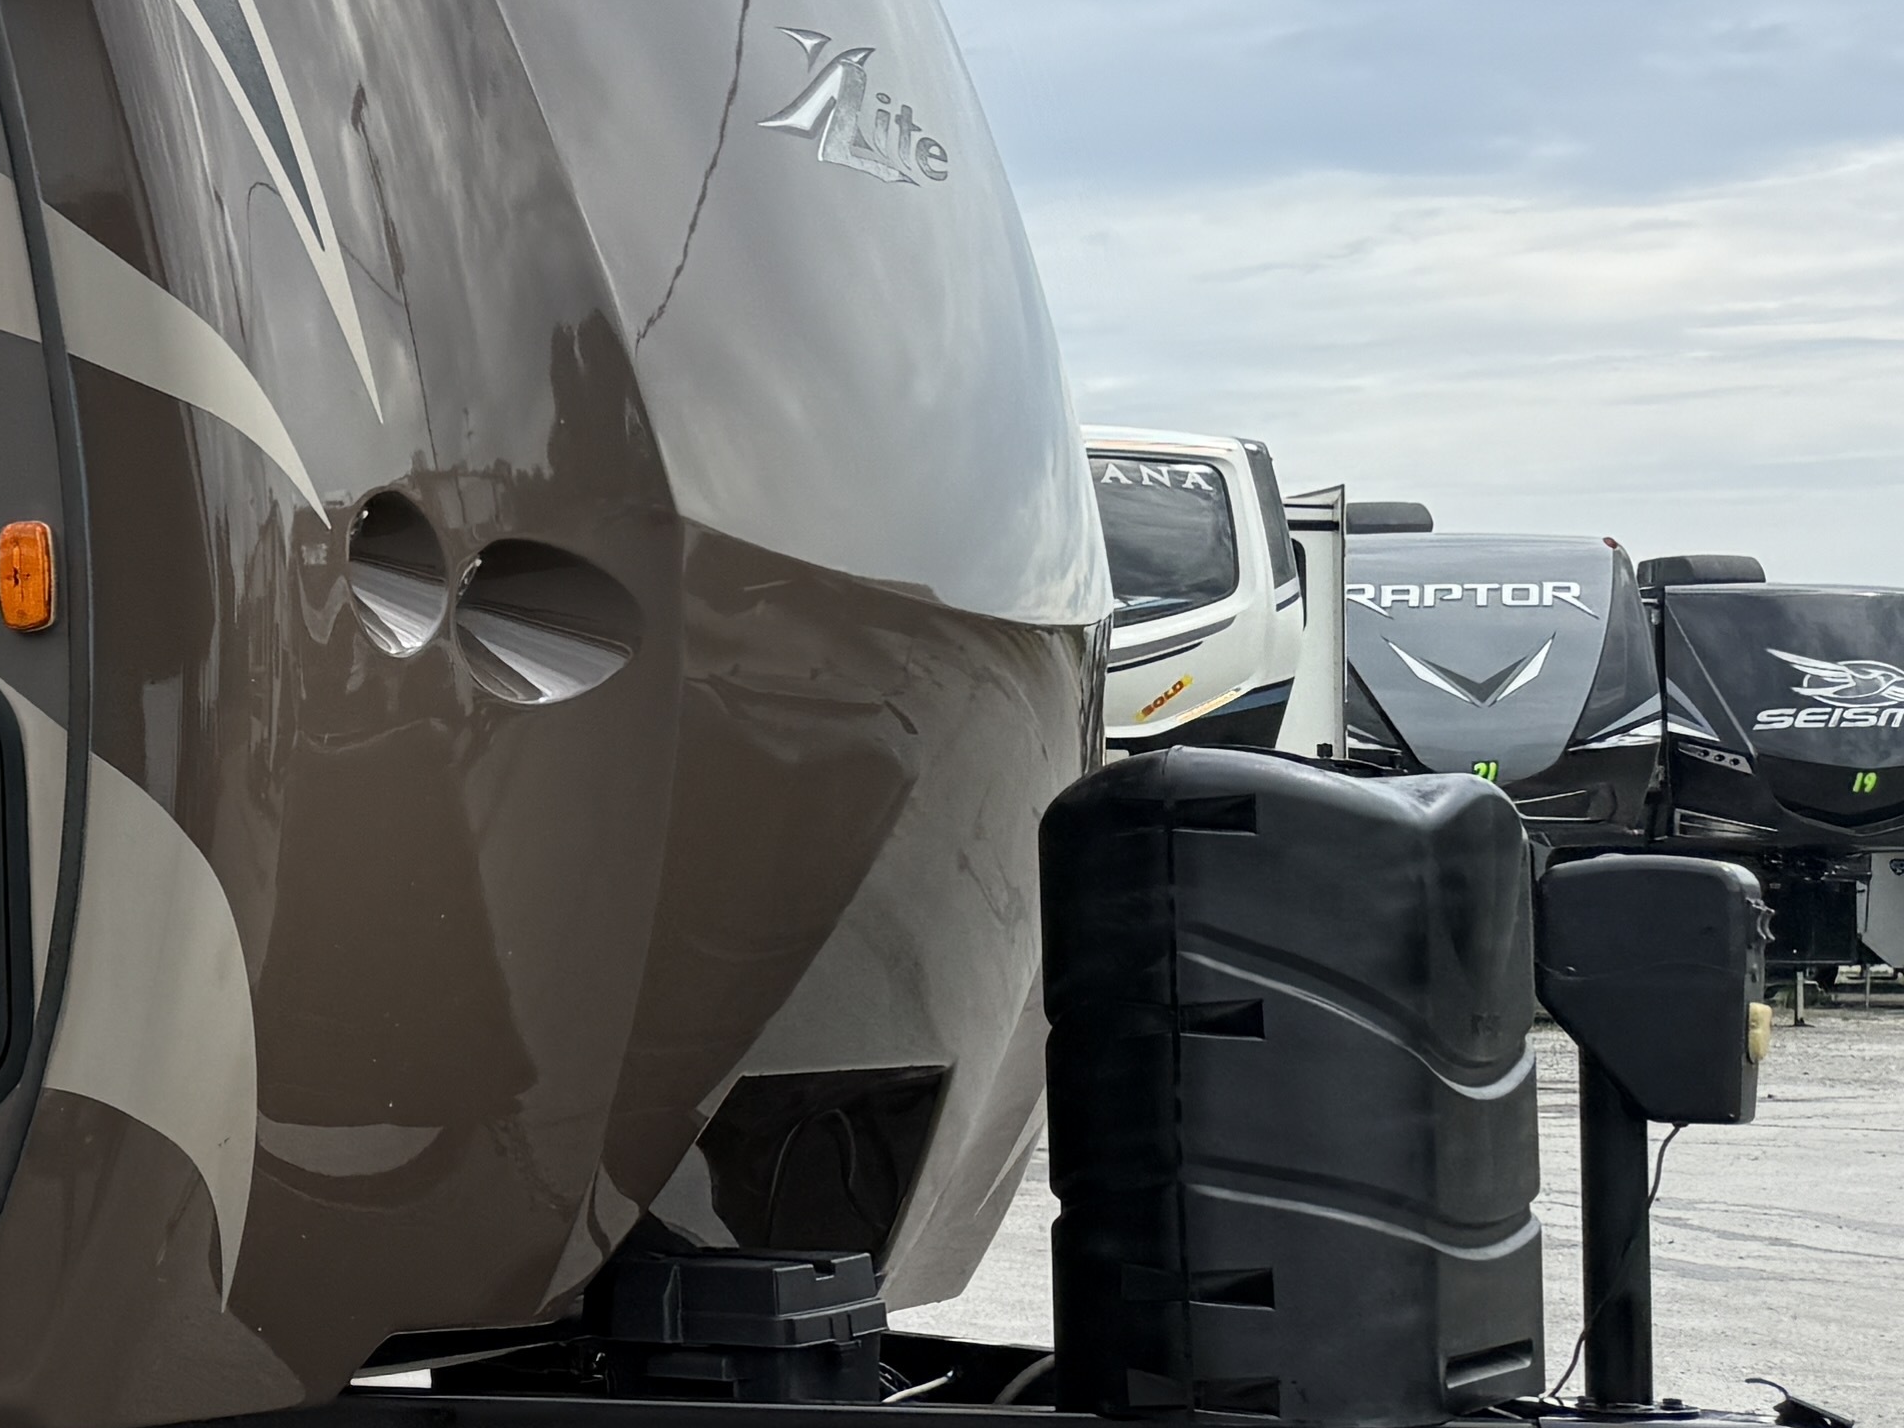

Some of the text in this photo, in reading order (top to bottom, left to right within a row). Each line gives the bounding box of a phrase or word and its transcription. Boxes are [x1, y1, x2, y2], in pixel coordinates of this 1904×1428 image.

[1344, 581, 1600, 620] RAPTOR
[1141, 680, 1184, 717] SOLD
[1852, 772, 1877, 793] 19
